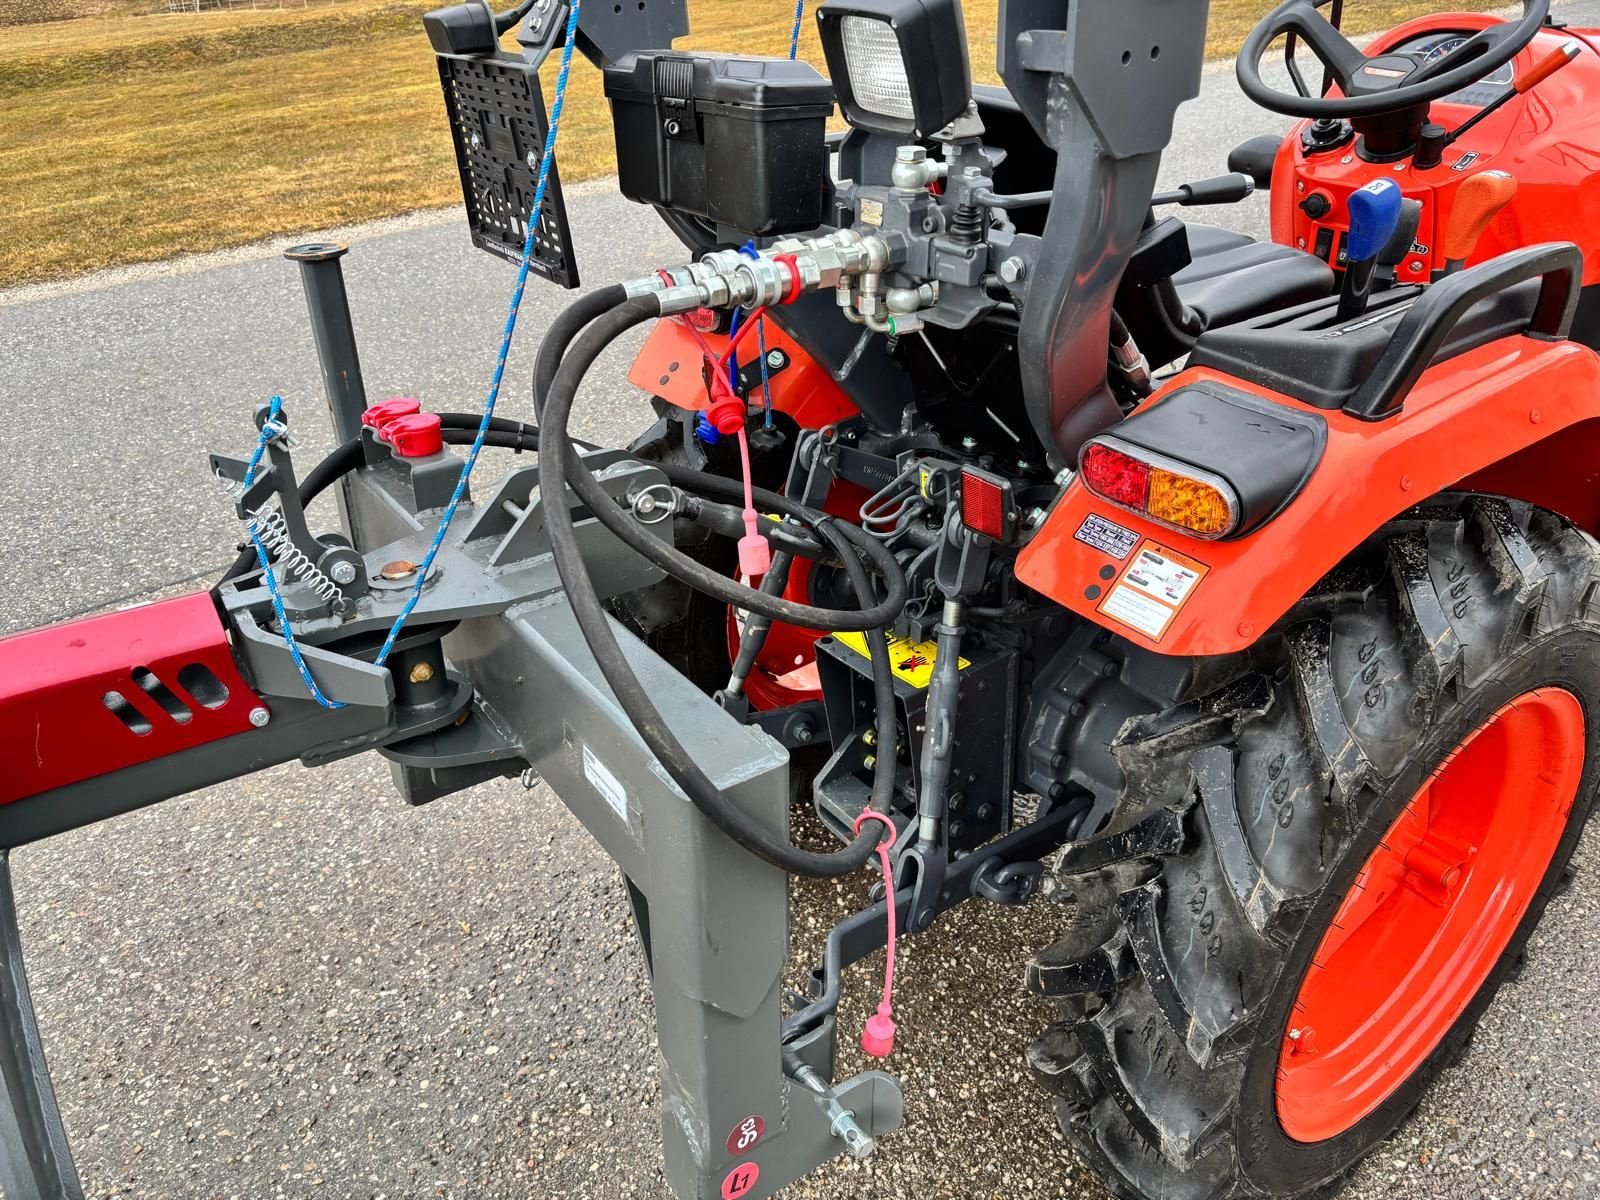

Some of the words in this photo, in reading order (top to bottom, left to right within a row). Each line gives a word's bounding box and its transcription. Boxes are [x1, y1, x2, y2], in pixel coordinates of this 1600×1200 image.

[1162, 549, 1190, 565] WARNING
[737, 1117, 758, 1149] S13
[729, 1172, 750, 1194] L1
